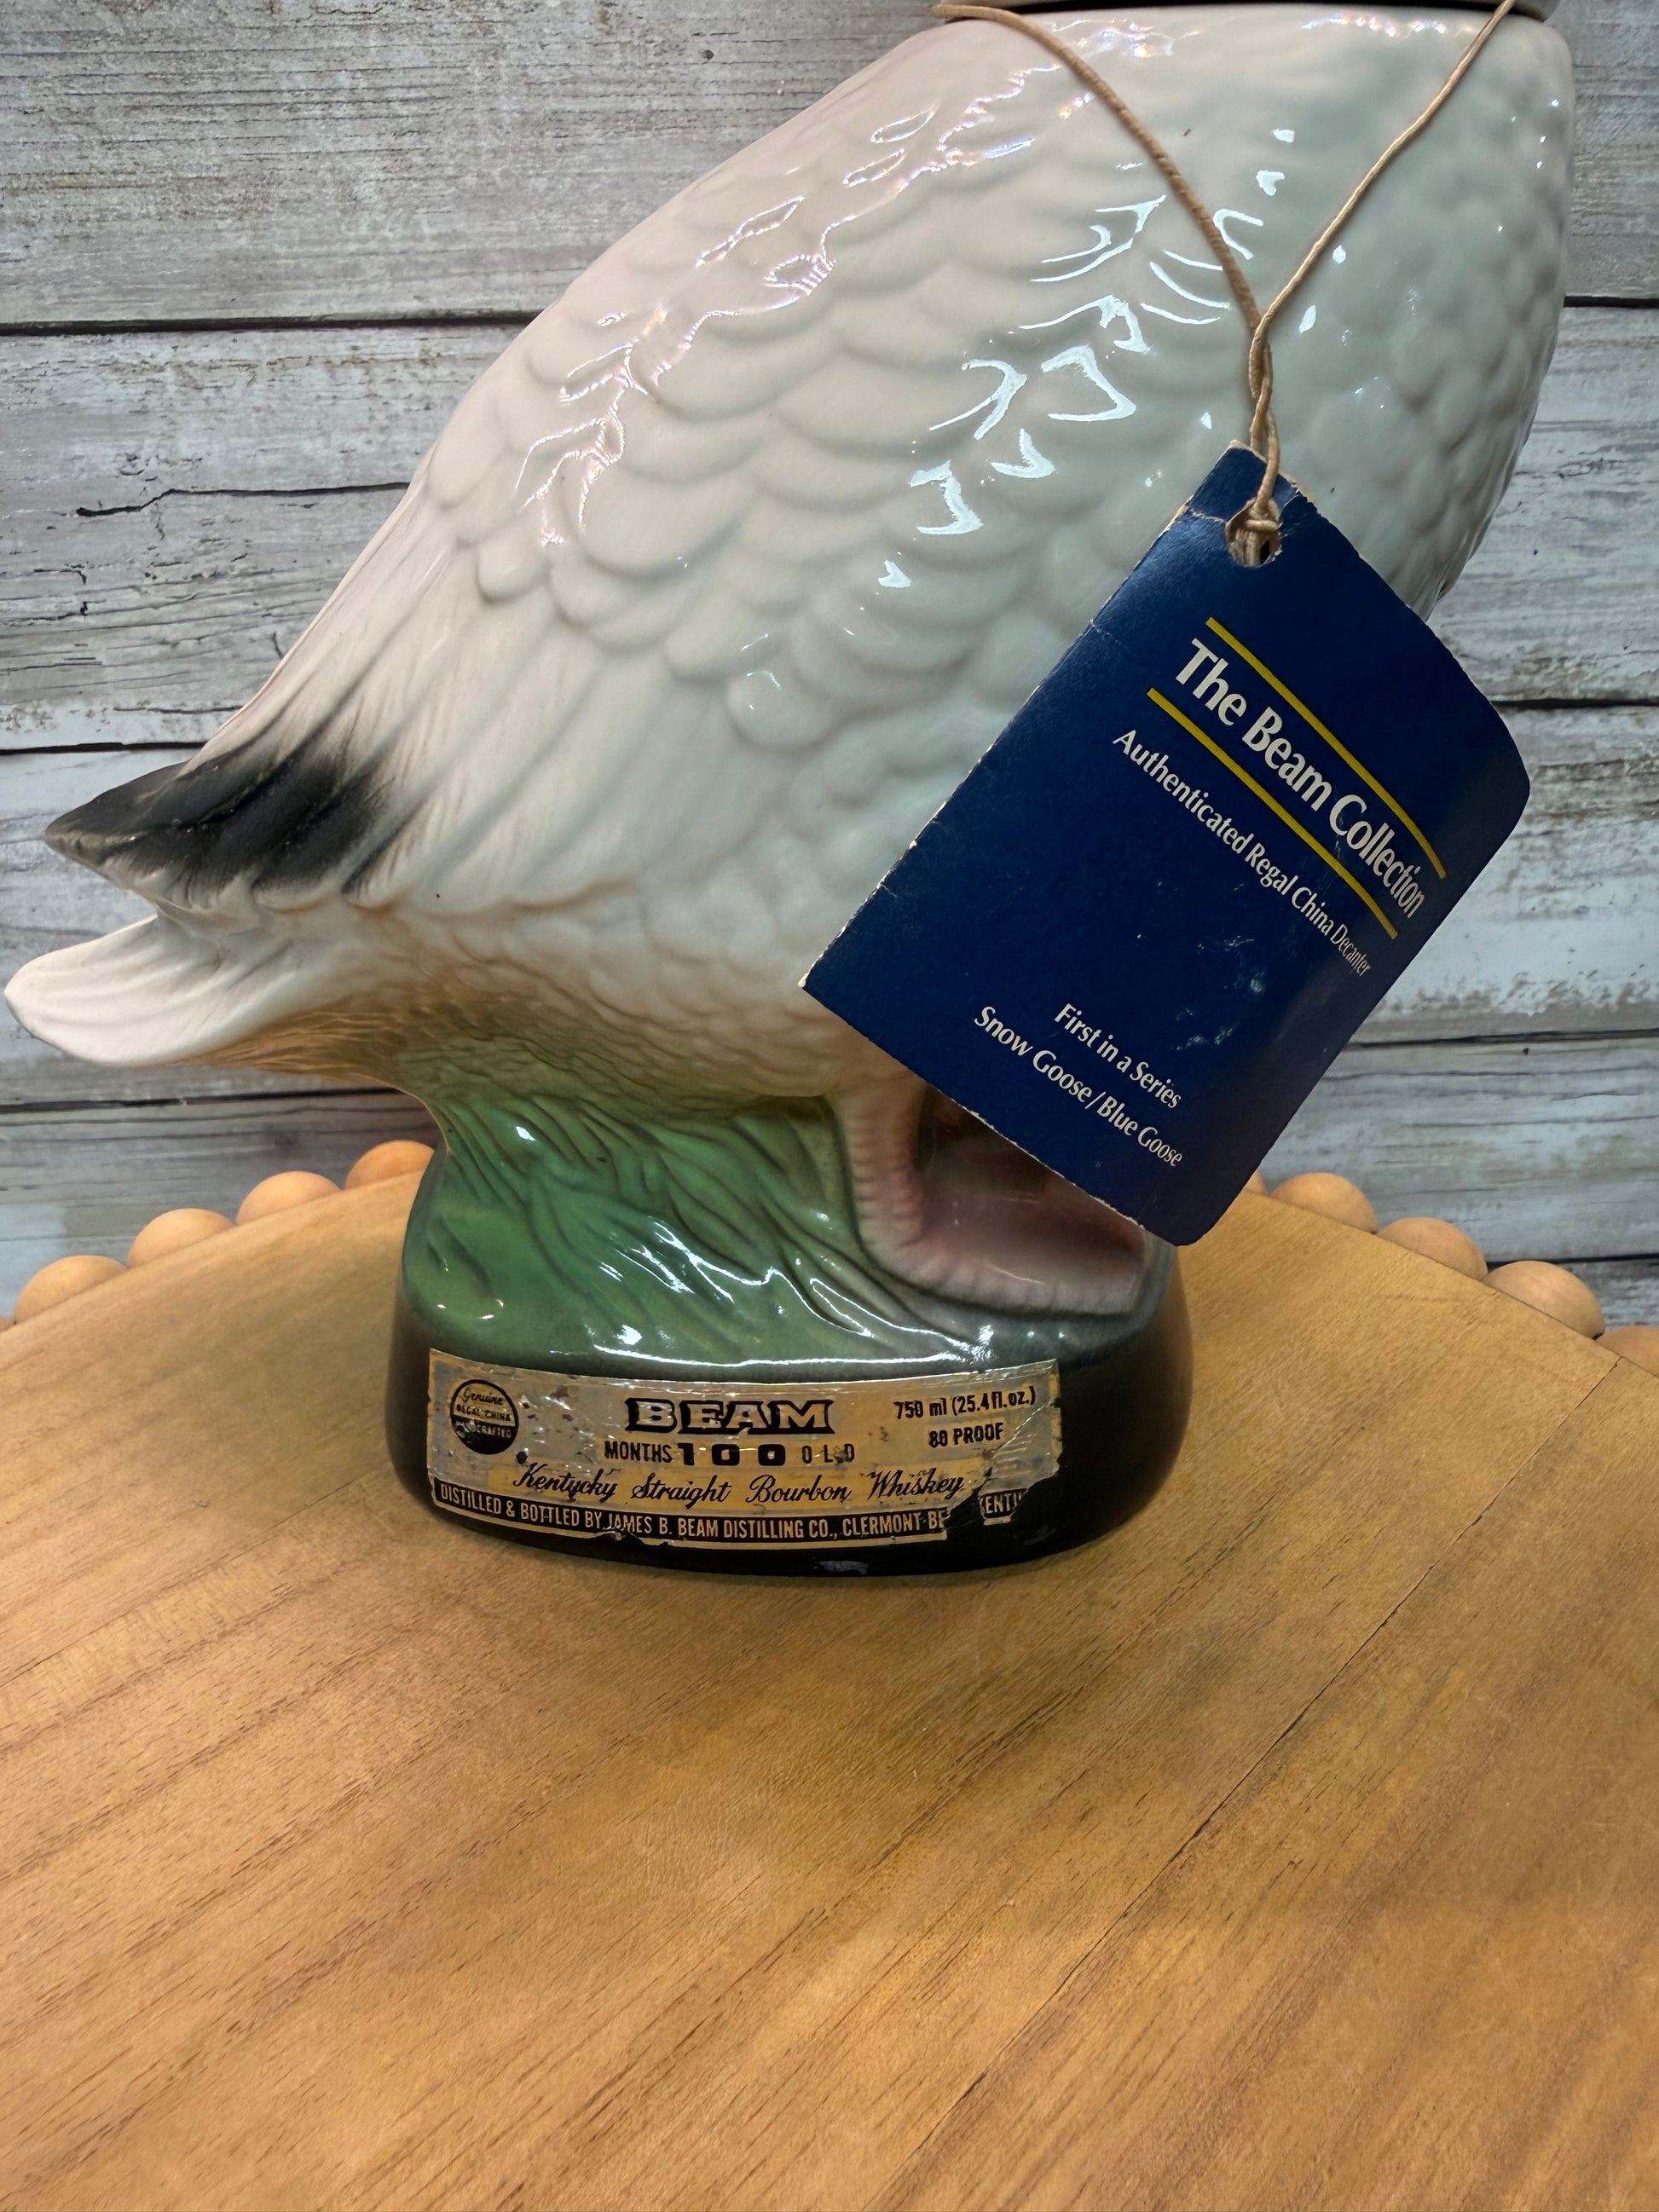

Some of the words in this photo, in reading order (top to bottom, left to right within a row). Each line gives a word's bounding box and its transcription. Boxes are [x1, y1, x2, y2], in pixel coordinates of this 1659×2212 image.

[1176, 638, 1247, 725] The
[1241, 707, 1332, 811] Beam
[1329, 794, 1425, 918] Collection
[1113, 730, 1254, 854] Authenticated
[1245, 842, 1296, 896] Regal
[1291, 887, 1334, 938] China
[1330, 923, 1372, 977] Decanter
[1054, 1003, 1101, 1048] First
[1096, 1034, 1119, 1063] in
[1116, 1055, 1132, 1073] a
[1129, 1061, 1182, 1109] Series
[974, 1006, 1033, 1057] Snow
[1137, 1126, 1183, 1167] Goose
[462, 1388, 504, 1405] Genuine
[624, 1398, 835, 1435] BEAM
[893, 1401, 923, 1419] 750
[929, 1397, 947, 1417] ml
[604, 1441, 673, 1464] MONTHS
[677, 1442, 786, 1466] 100
[928, 1429, 948, 1448] 80
[953, 1422, 1004, 1445] PROOF
[513, 1462, 618, 1503] Kentucky
[631, 1472, 732, 1509] Straight
[745, 1474, 852, 1504] Bourbon
[865, 1468, 964, 1500] Whiskey
[440, 1484, 502, 1515] DISTILLED
[505, 1500, 516, 1517] &
[520, 1503, 580, 1528] BOTTLED
[585, 1510, 602, 1528] BY
[607, 1514, 653, 1534] JAMES
[658, 1516, 672, 1535] B.
[678, 1518, 718, 1538] BEAM
[725, 1519, 804, 1539] DISTILLING
[843, 1512, 921, 1537] CLERMONT
